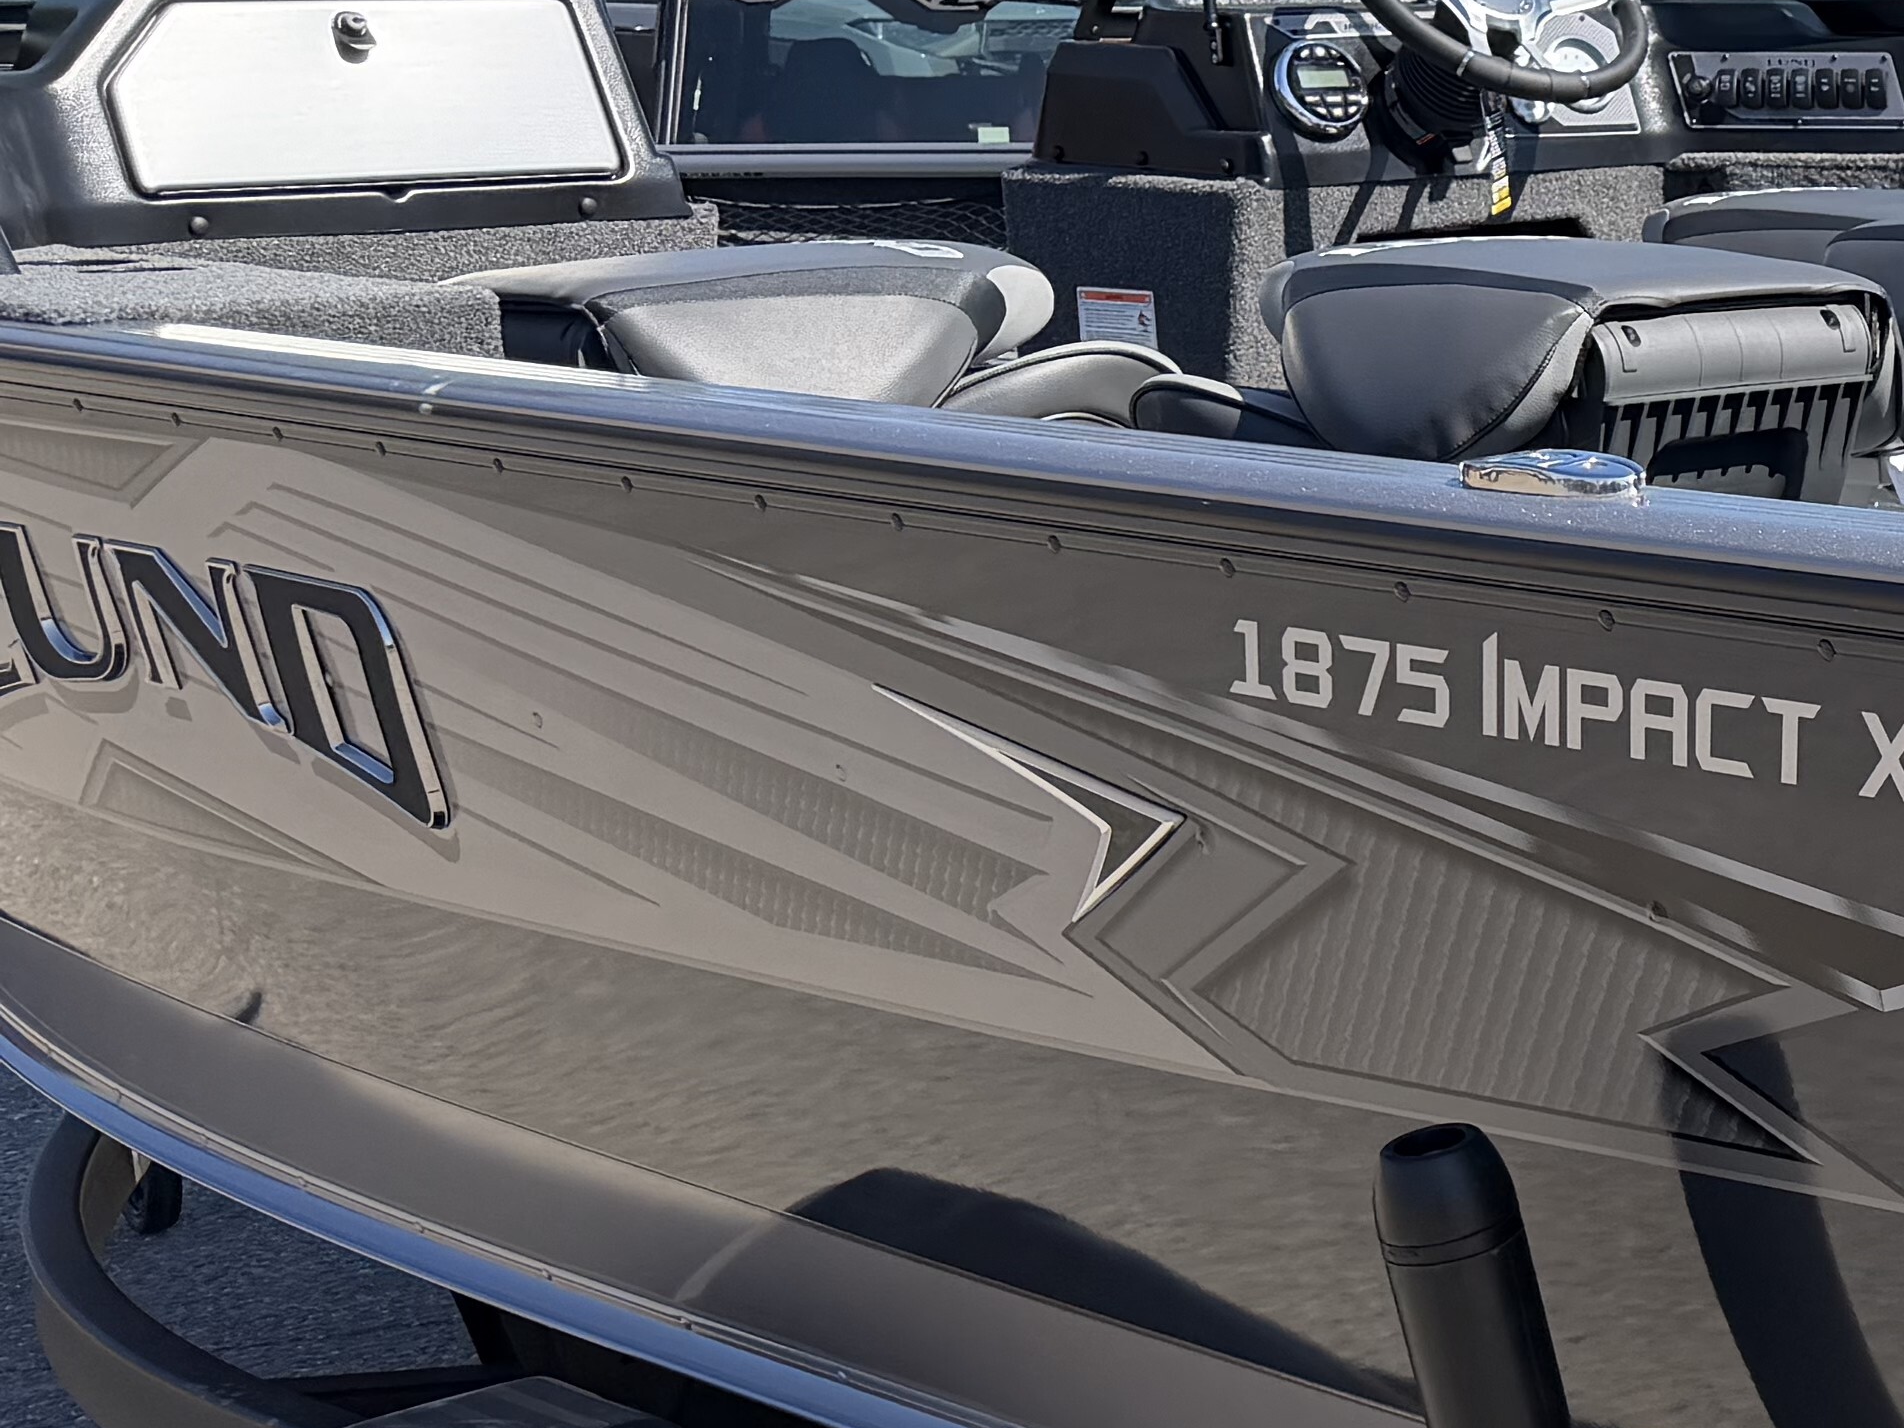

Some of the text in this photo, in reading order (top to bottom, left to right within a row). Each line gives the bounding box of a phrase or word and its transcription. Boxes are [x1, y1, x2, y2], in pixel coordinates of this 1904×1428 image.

[0, 521, 450, 829] UND
[1229, 619, 1450, 729] 1875
[1482, 632, 1821, 786] IMPACT
